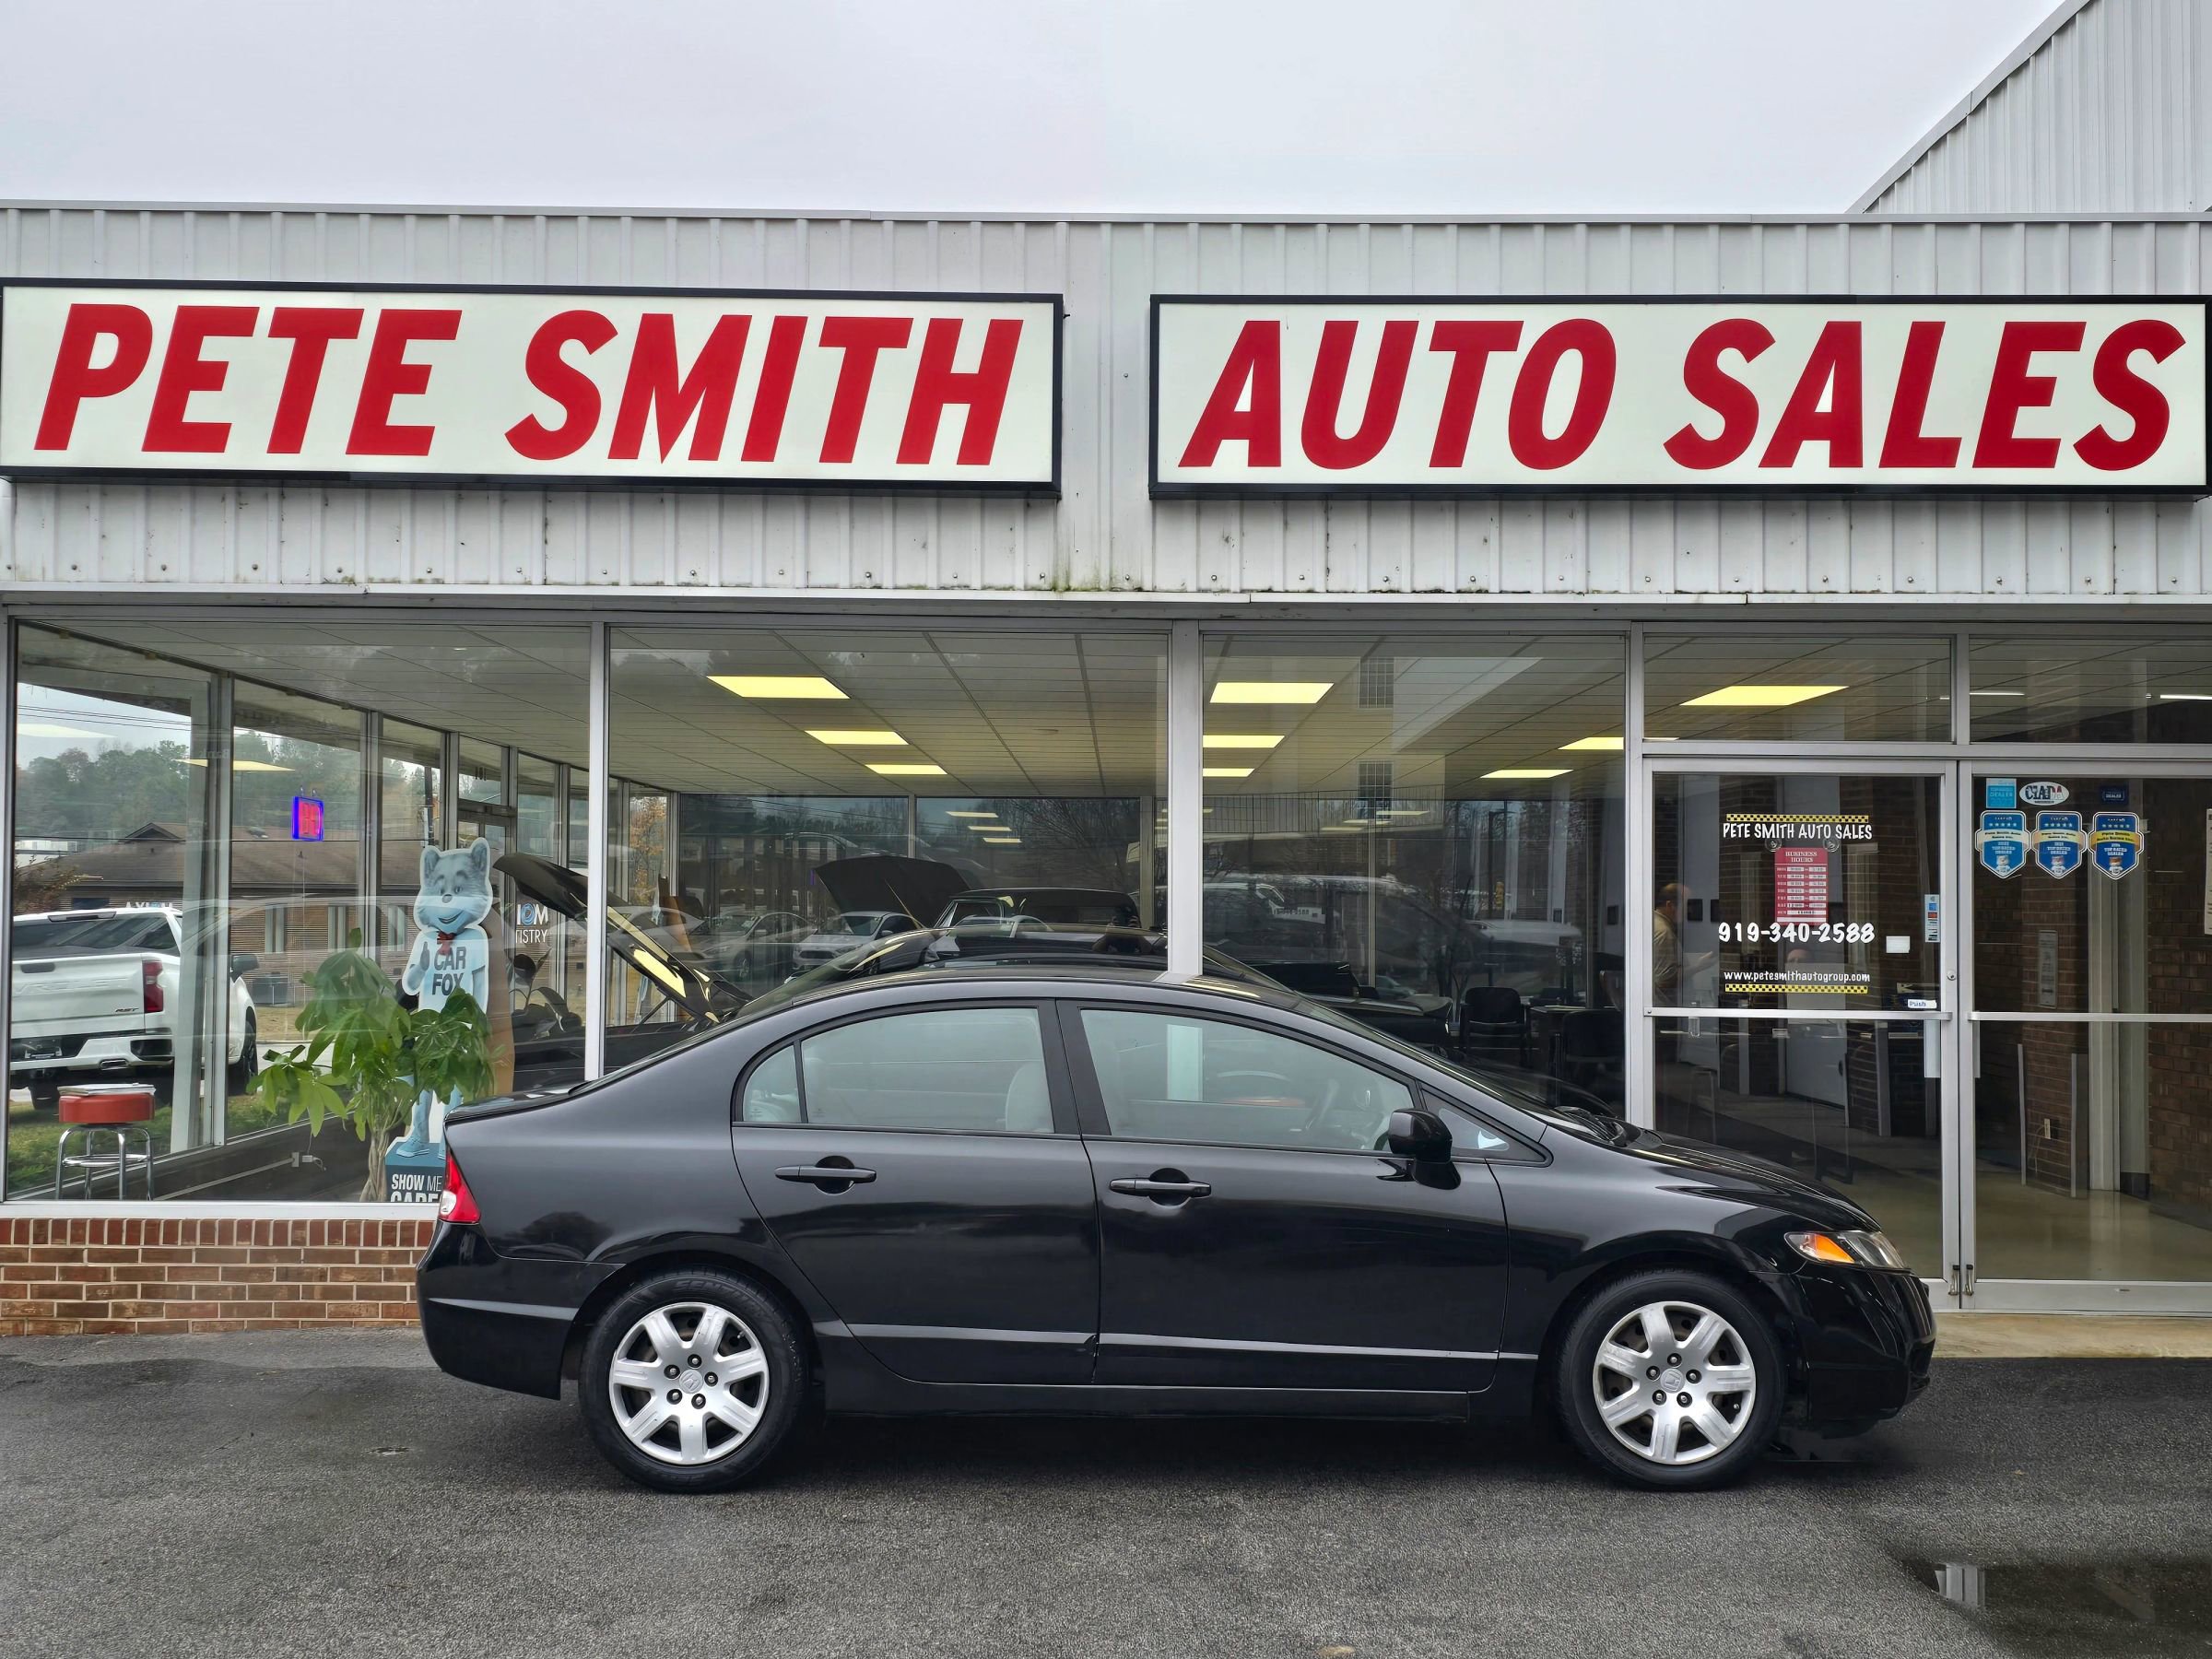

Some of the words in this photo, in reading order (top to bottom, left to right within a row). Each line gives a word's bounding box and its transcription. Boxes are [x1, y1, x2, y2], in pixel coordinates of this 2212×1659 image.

[35, 304, 462, 455] PETE
[505, 311, 1023, 465] SMITH
[1180, 319, 1616, 469] AUTO
[1664, 319, 2185, 470] SALES
[1723, 823, 1751, 839] PETE
[1754, 823, 1794, 839] SMITH
[1798, 824, 1831, 839] AUTO
[1835, 824, 1872, 840] SALES
[517, 903, 548, 926] IOM
[515, 929, 548, 944] TISTRY
[1718, 922, 1876, 943] 919-340-2588
[434, 946, 466, 971] CAR
[1724, 970, 1870, 983] www.petesmithautogroup.com
[391, 1173, 425, 1190] SHOW
[427, 1175, 443, 1192] ME
